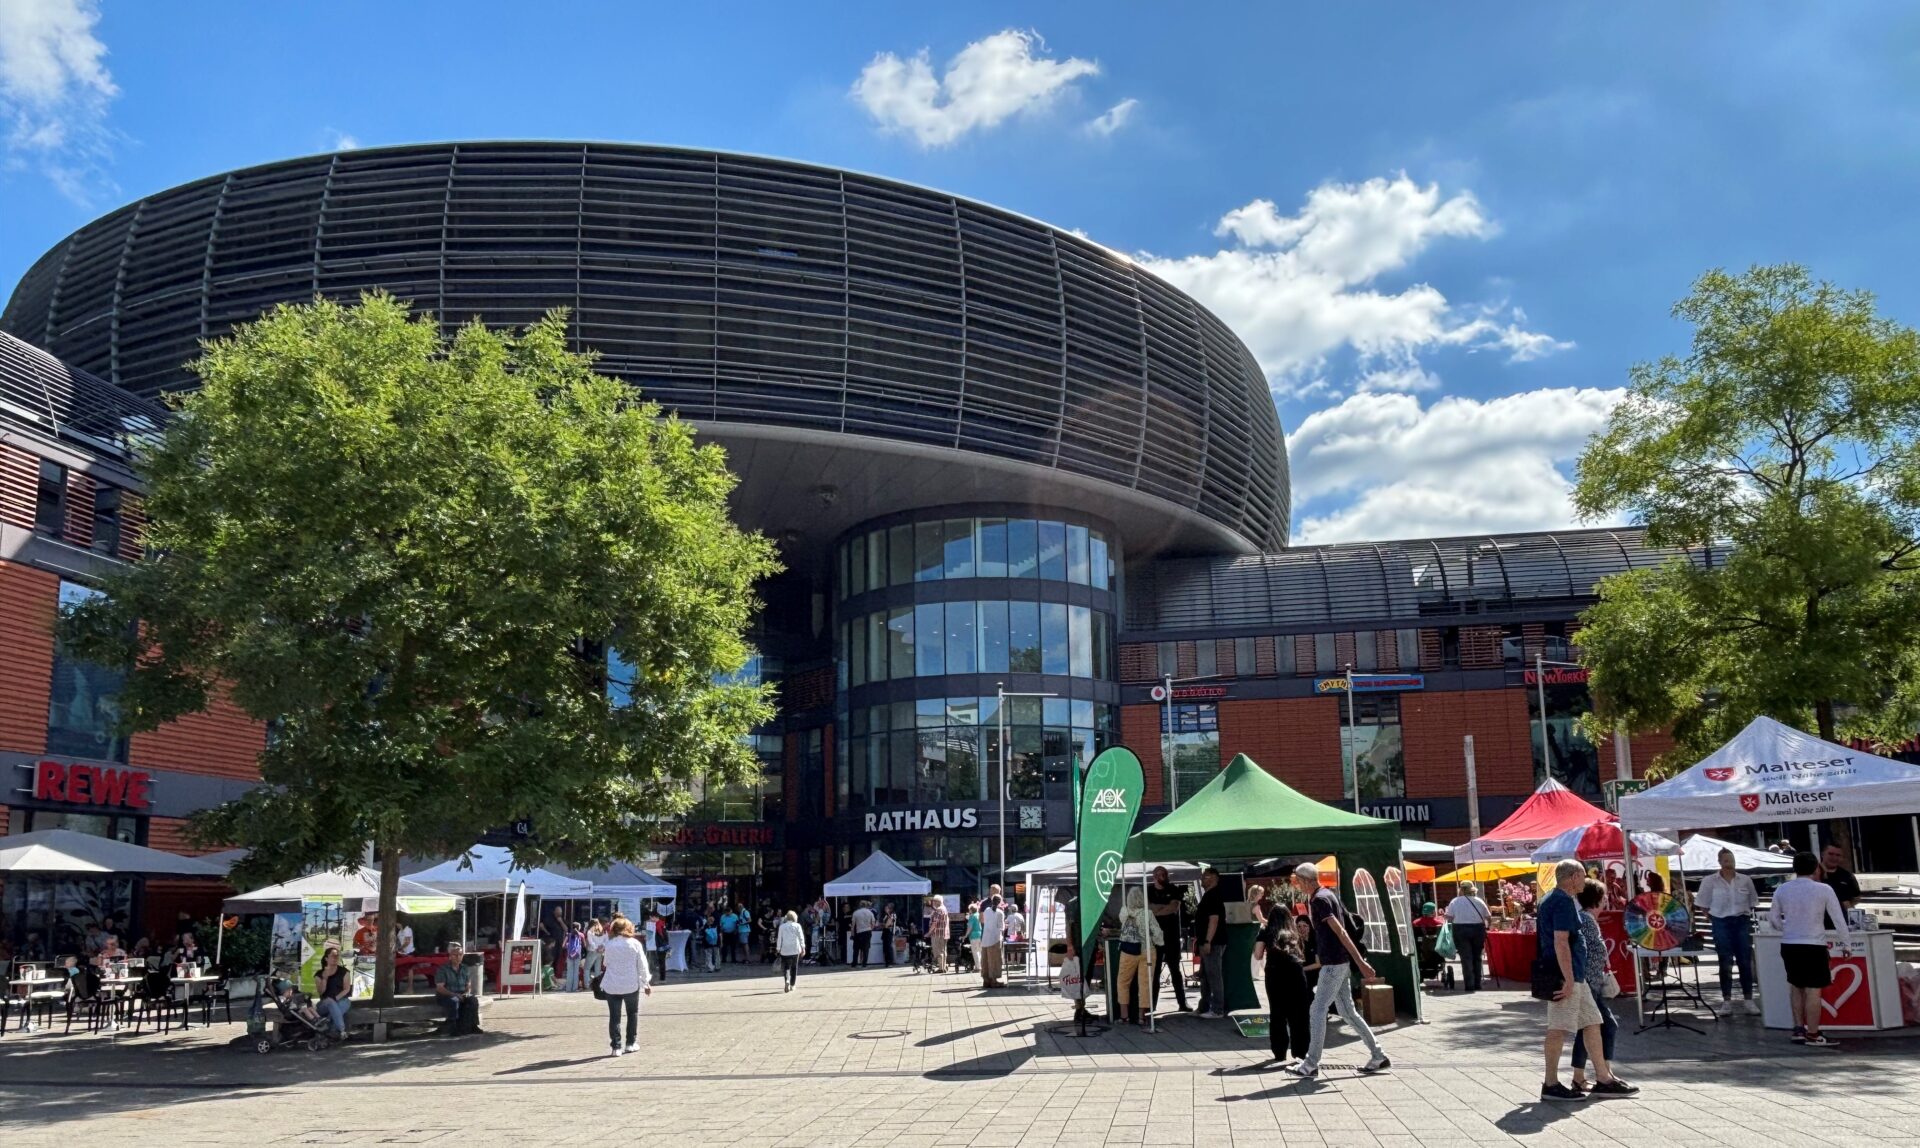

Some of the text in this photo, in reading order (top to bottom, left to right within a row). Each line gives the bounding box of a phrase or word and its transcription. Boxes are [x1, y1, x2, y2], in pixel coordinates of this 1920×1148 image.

[1745, 756, 1855, 775] Malteser
[36, 761, 150, 808] REWE
[1092, 788, 1127, 808] AOK
[1765, 790, 1834, 805] Malteser
[865, 808, 977, 832] RATHAUS
[1361, 805, 1430, 822] SATURN
